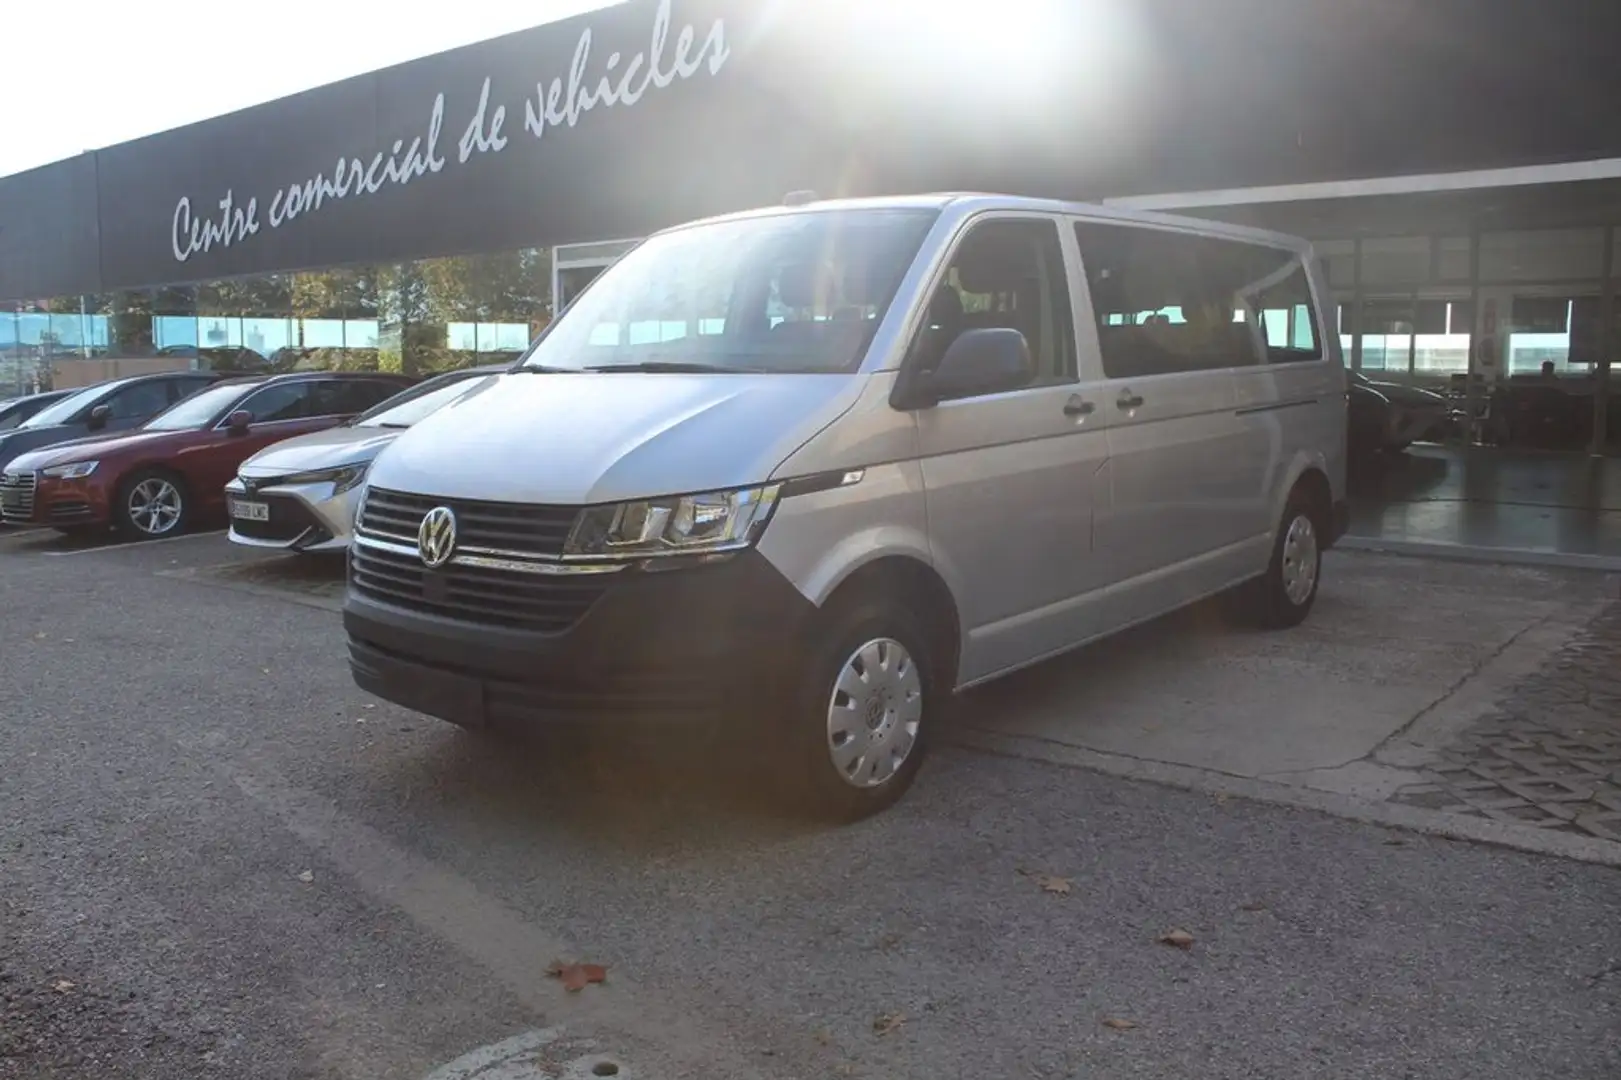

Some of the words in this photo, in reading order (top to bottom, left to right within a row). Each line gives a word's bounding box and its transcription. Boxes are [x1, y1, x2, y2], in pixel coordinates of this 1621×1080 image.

[172, 189, 260, 262] Centre
[268, 92, 445, 228] comercial
[458, 76, 508, 164] de
[524, 0, 731, 139] vehicles
